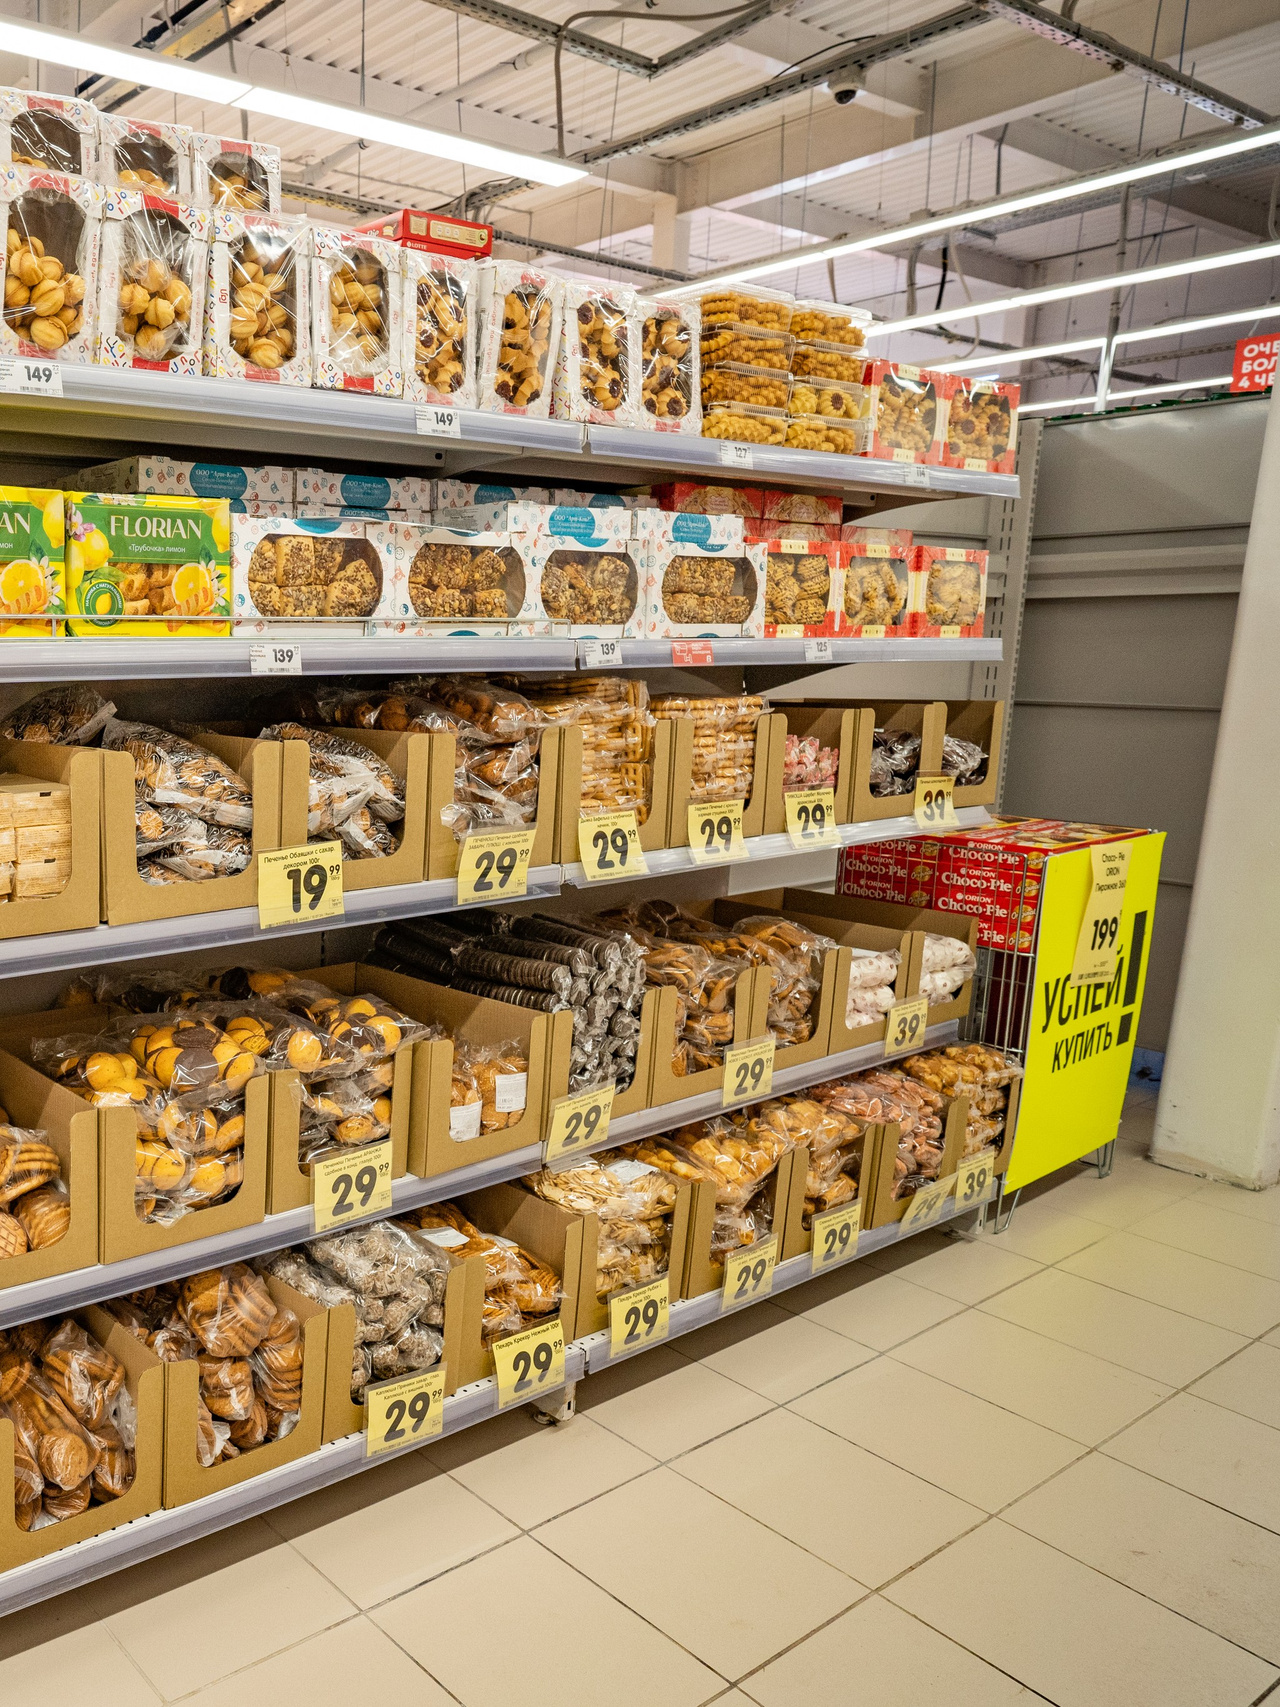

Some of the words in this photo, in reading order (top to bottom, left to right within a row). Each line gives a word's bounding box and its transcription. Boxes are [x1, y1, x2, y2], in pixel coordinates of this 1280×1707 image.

[24, 365, 52, 383] 149
[1238, 376, 1250, 388] 4
[434, 411, 453, 427] 149
[110, 515, 202, 540] FLORIAN
[129, 543, 164, 553] «Трубочка»
[165, 545, 186, 553] лимон
[272, 649, 294, 663] 139
[600, 643, 615, 655] 139
[816, 641, 828, 652] 125
[797, 803, 825, 839] 29
[826, 804, 832, 813] 99
[923, 789, 945, 821] 39
[593, 828, 628, 869] 29
[628, 829, 636, 839] 99
[700, 816, 732, 854] 29
[733, 817, 741, 826] 99
[976, 842, 1005, 851] ORION
[264, 853, 288, 864] Печенье
[283, 860, 308, 870] декором
[309, 857, 321, 865] 100г
[473, 848, 517, 892] 29
[520, 849, 529, 858] 99
[967, 869, 996, 878] ORION
[1106, 867, 1120, 877] ORION
[287, 864, 328, 913] 19
[329, 864, 340, 875] 99
[965, 894, 993, 903] ORION
[1095, 884, 1118, 894] Пирожное
[1091, 916, 1118, 950] 199
[894, 1013, 920, 1047] 39
[1052, 1022, 1113, 1073] КУПИТЬ
[734, 1058, 764, 1096] 29
[562, 1104, 601, 1148] 29
[345, 1154, 362, 1163] Печенье
[332, 1165, 377, 1217] 29
[379, 1162, 390, 1173] 99
[963, 1168, 986, 1201] 39
[910, 1193, 941, 1225] 29
[823, 1222, 851, 1262] 29
[734, 1258, 766, 1300] 29
[496, 1341, 513, 1350] Пекарь
[513, 1334, 530, 1344] Крекер
[531, 1327, 550, 1337] Нежный
[550, 1322, 560, 1330] 100г
[624, 1299, 658, 1345] 29
[660, 1296, 667, 1306] 99
[513, 1342, 553, 1393] 29
[553, 1339, 563, 1350] 99
[384, 1391, 430, 1443] 29
[432, 1388, 442, 1399] 99
